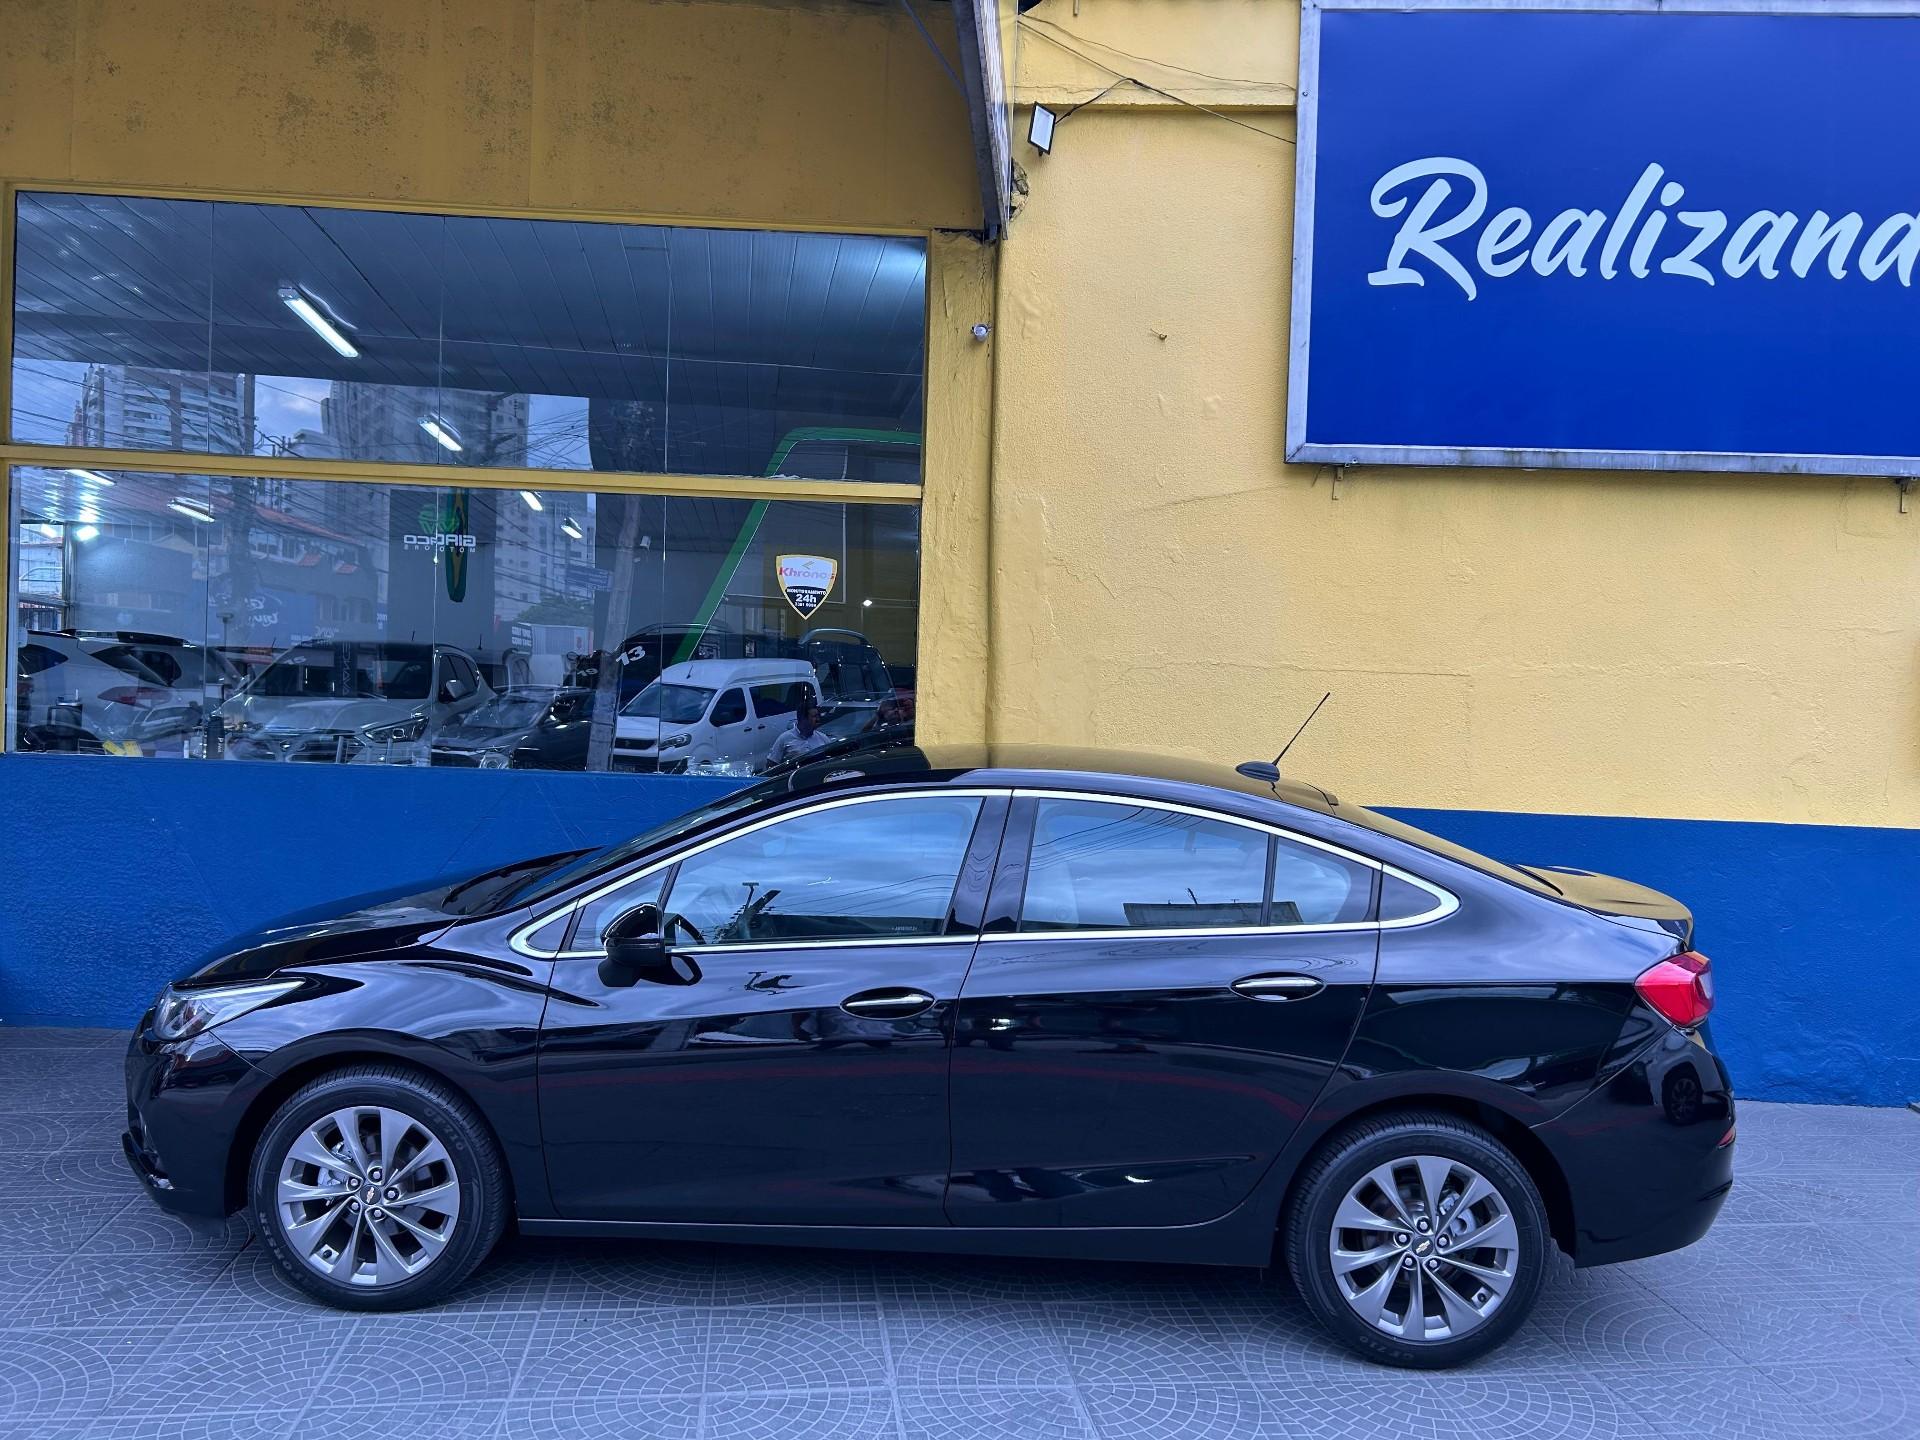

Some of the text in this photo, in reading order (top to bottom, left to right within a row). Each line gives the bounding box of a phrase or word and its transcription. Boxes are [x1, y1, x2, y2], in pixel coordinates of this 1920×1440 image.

[779, 566, 836, 580] Khronos
[796, 594, 817, 603] 24h
[615, 645, 646, 666] 13
